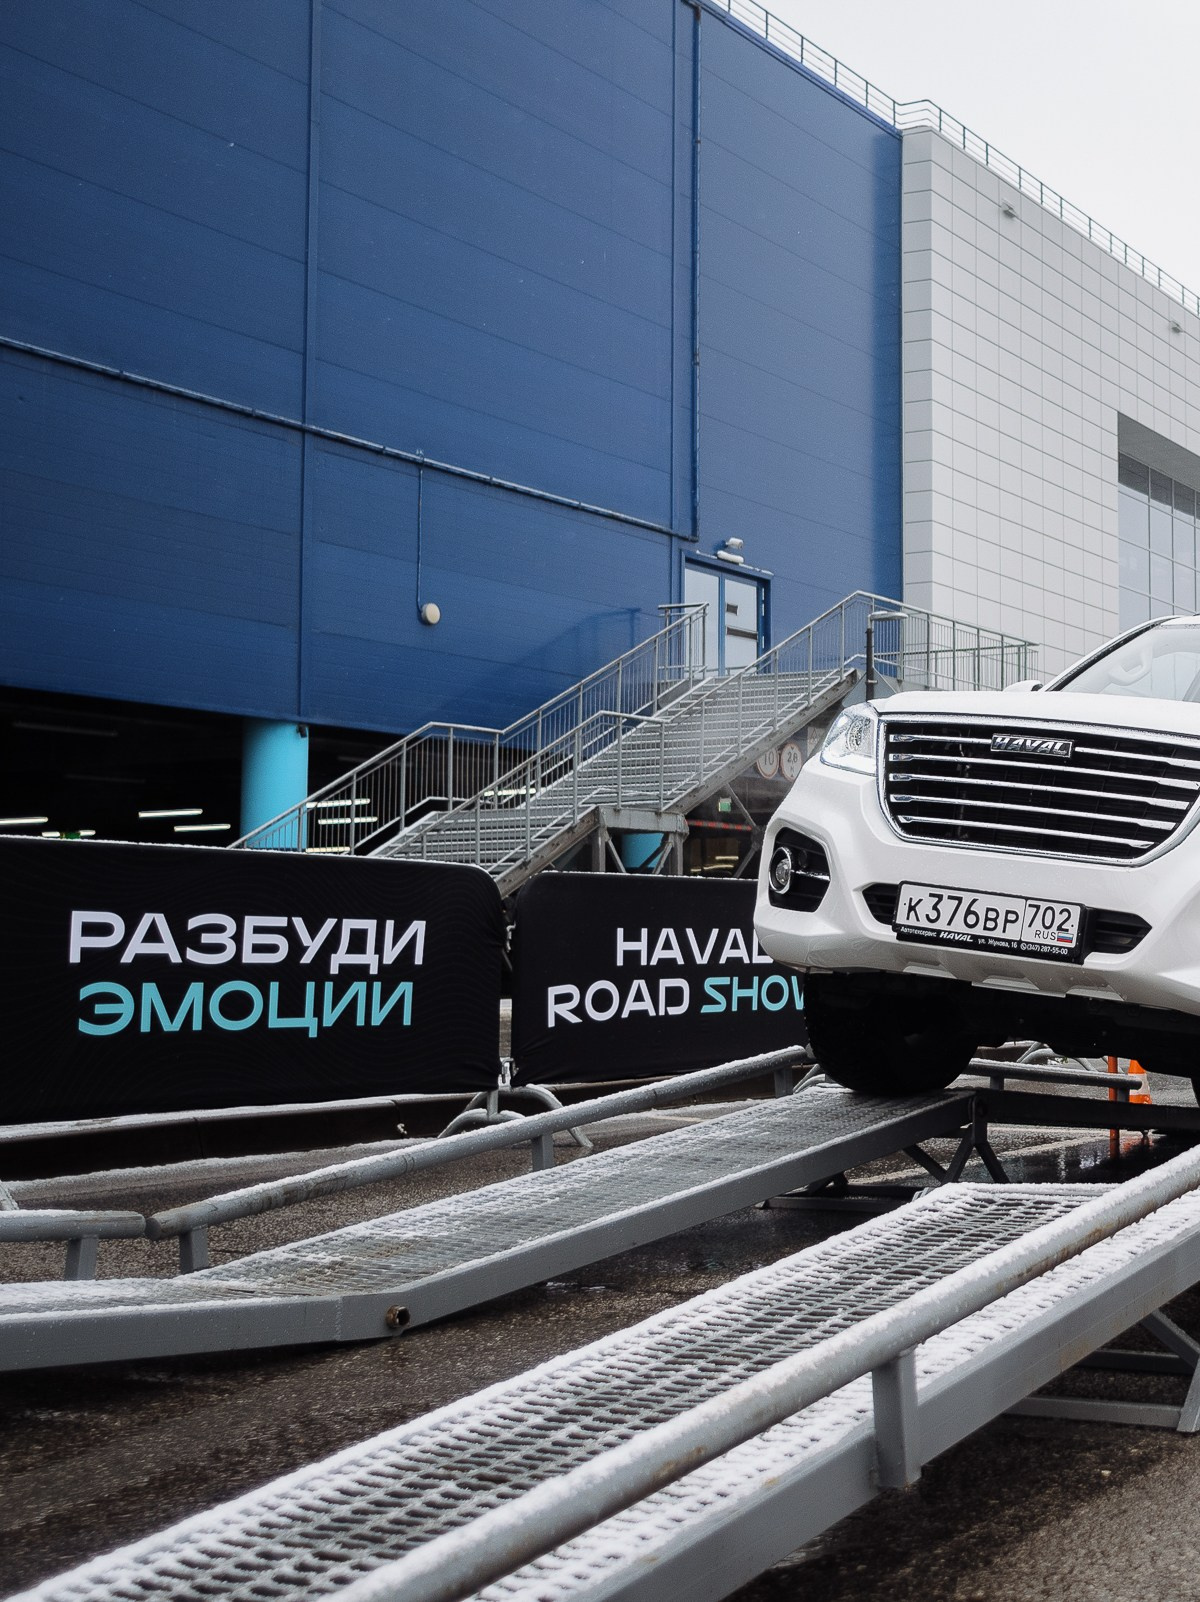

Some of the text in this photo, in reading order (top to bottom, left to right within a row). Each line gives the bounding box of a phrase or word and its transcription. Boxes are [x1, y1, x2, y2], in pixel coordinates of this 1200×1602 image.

[993, 737, 1067, 755] HAVAL
[1027, 904, 1073, 933] 702
[1034, 929, 1057, 941] RUS
[69, 910, 426, 975] РАЗБУДИ
[616, 927, 774, 967] HAVAL
[939, 931, 974, 943] HAVAL
[1009, 941, 1018, 949] 16
[78, 980, 414, 1038] ЭМОЦИИ
[547, 978, 691, 1028] ROAD
